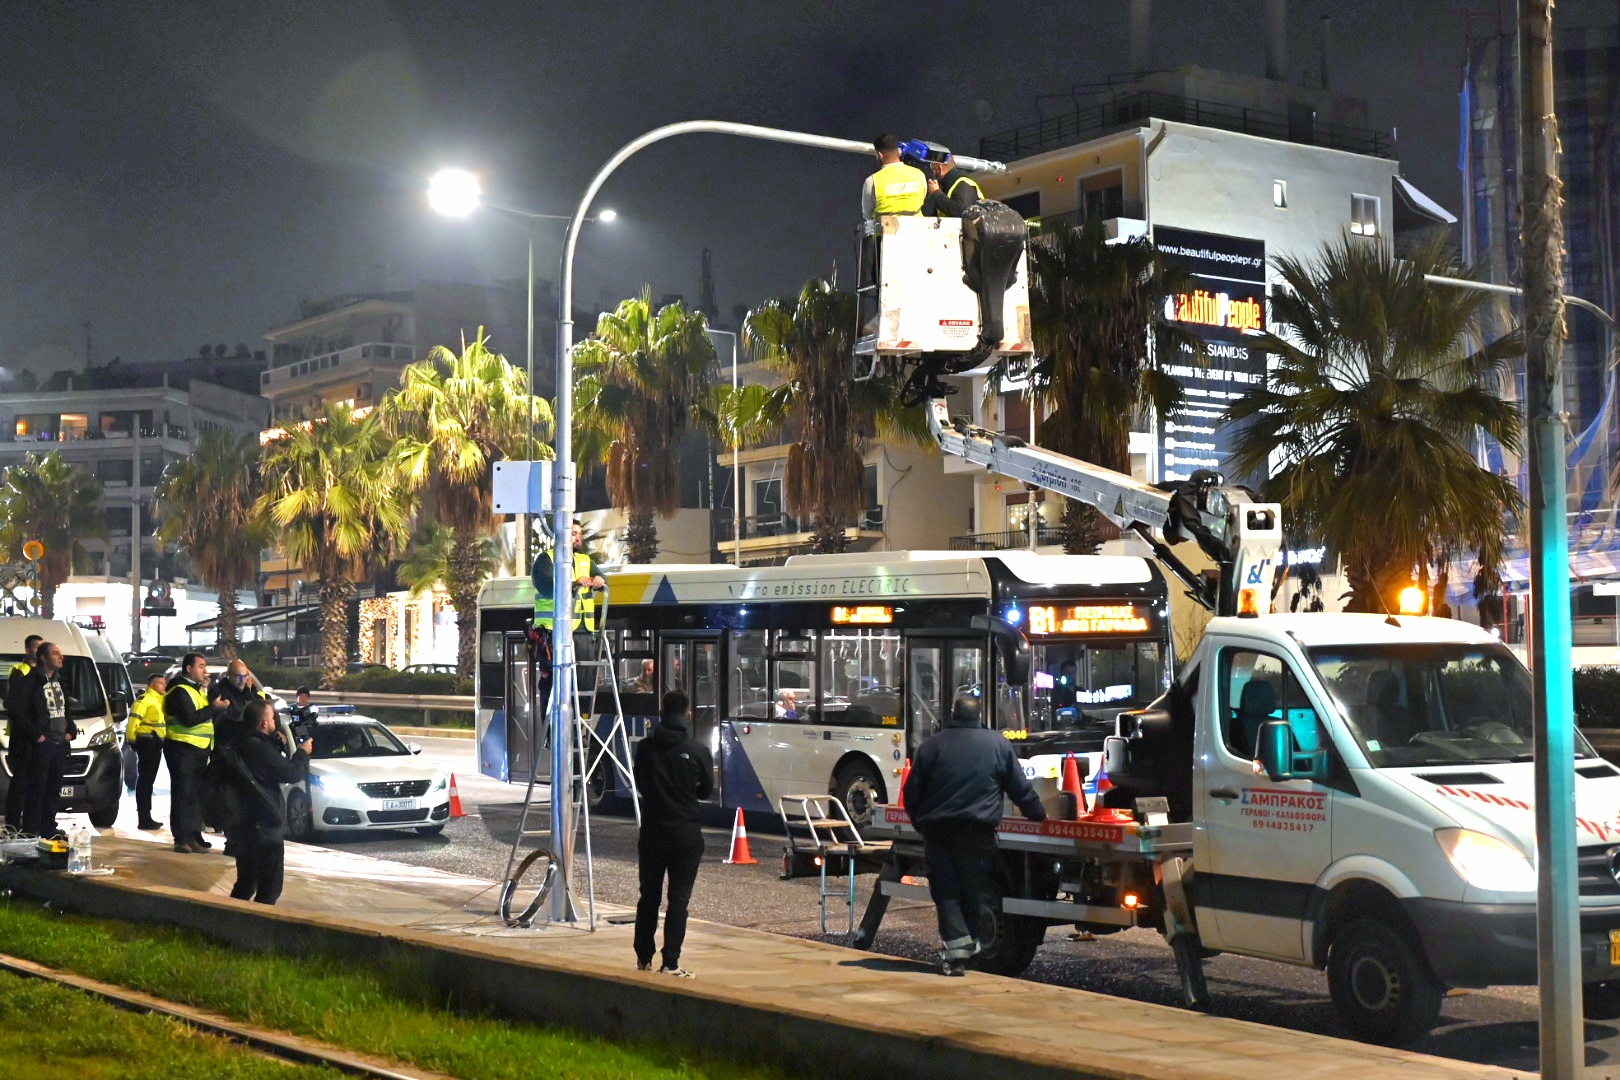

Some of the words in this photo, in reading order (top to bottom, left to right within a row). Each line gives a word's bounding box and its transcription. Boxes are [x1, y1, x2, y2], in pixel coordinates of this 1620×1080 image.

[1157, 244, 1263, 268] www.beautifulpeoplepr.gr
[1207, 343, 1249, 360] SIANIDIS
[774, 581, 835, 596] emission
[843, 578, 910, 594] ELECTRIC
[1002, 729, 1028, 739] 2046
